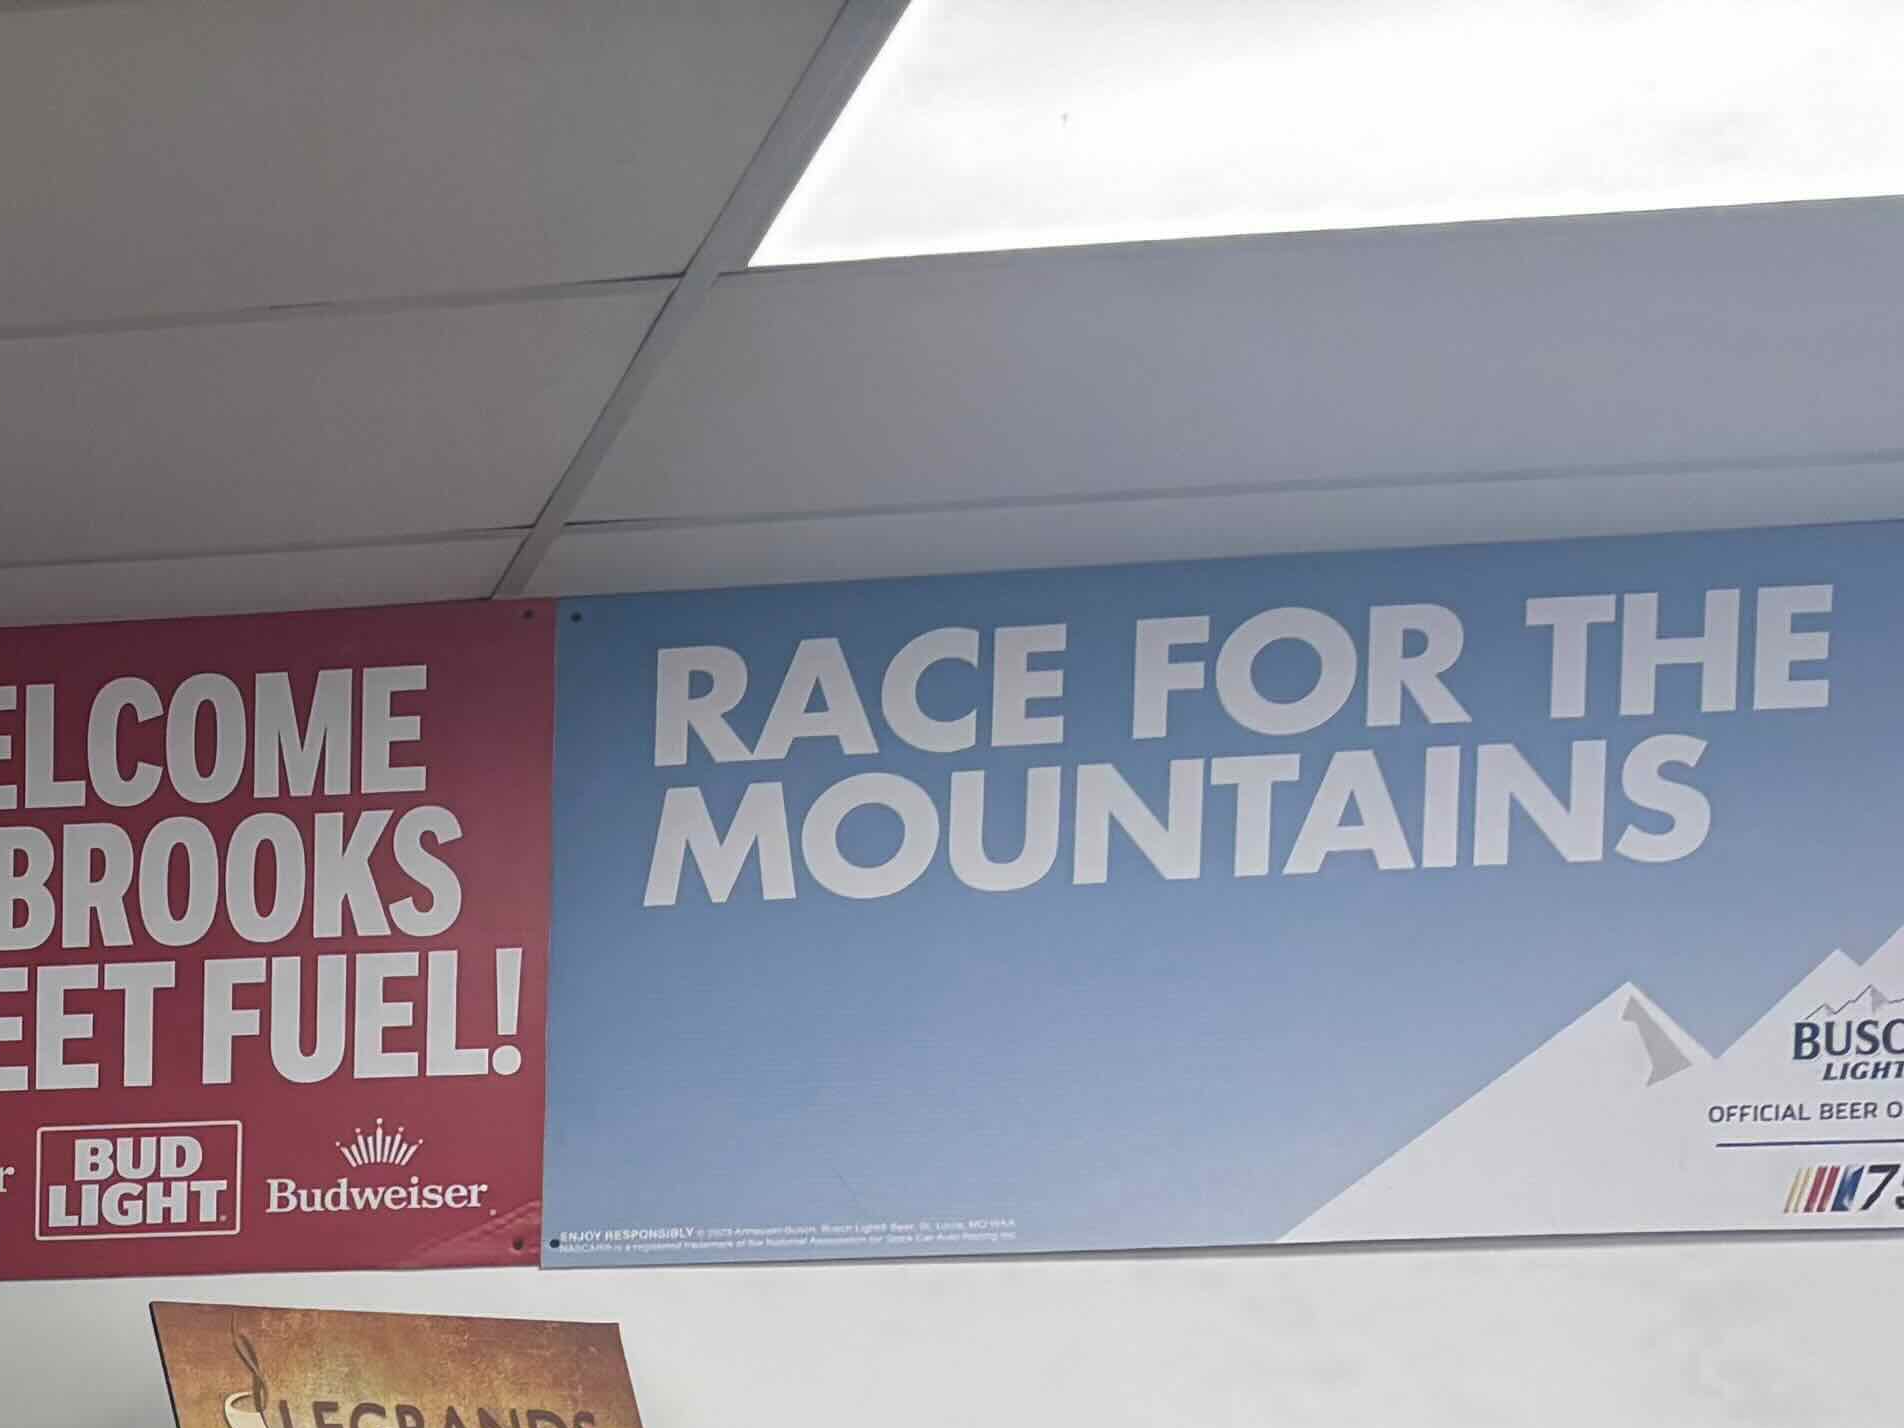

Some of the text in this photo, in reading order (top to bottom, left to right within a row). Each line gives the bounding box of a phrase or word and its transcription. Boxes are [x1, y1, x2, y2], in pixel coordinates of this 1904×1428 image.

[654, 584, 1834, 767] RACE FOR THE
[643, 733, 1711, 906] MOUNTAINS
[202, 947, 524, 1085] FUEL!
[1708, 1101, 1878, 1123] OFFICIAL BEER
[75, 1137, 201, 1178] BUD
[47, 1181, 227, 1228] LIGHT
[265, 1178, 487, 1216] Budweiser
